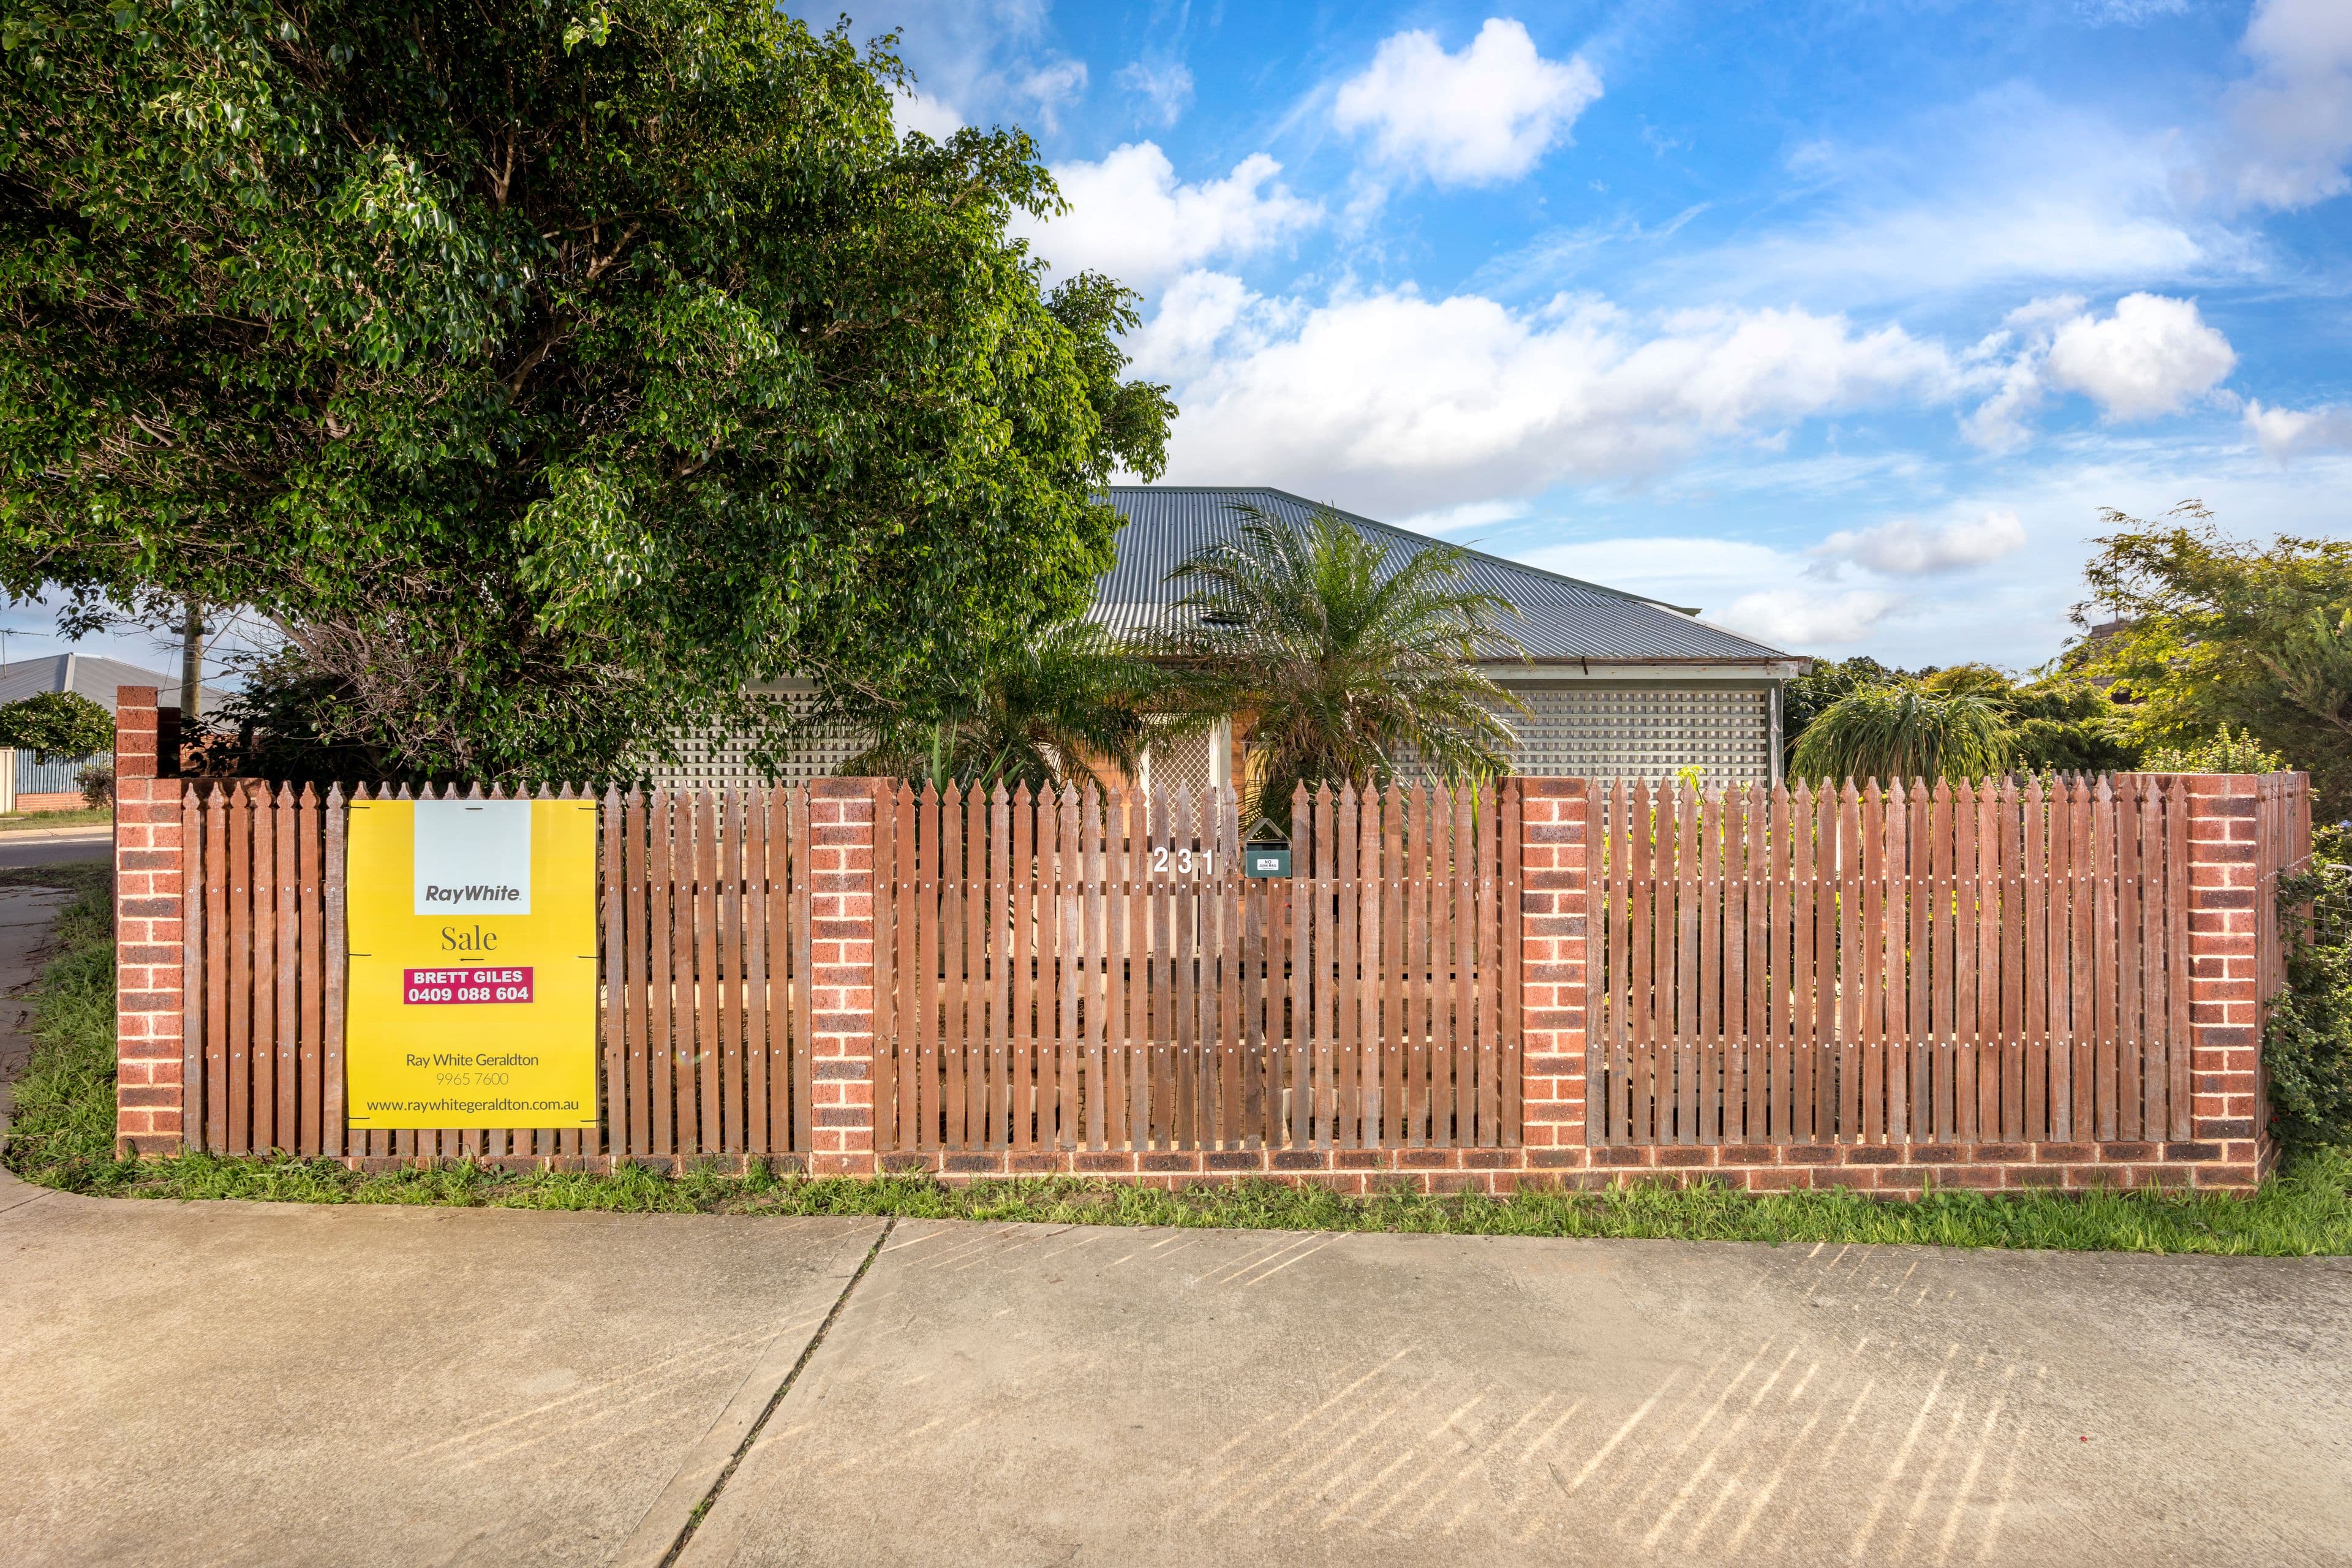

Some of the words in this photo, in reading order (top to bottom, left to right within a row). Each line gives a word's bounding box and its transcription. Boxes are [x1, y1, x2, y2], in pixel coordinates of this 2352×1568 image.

[442, 925, 497, 951] Sale
[413, 971, 469, 984] BRETT
[473, 971, 522, 983] GILES
[409, 988, 452, 1001] 0409
[458, 987, 490, 1001] 088
[496, 987, 529, 1000] 604
[406, 1054, 430, 1068] Ray
[434, 1054, 473, 1066] White
[475, 1053, 539, 1066] Geraldton
[436, 1072, 470, 1085] 9965
[475, 1072, 509, 1085] 7600
[367, 1098, 579, 1114] www.raywhitegeraldton.com.au
